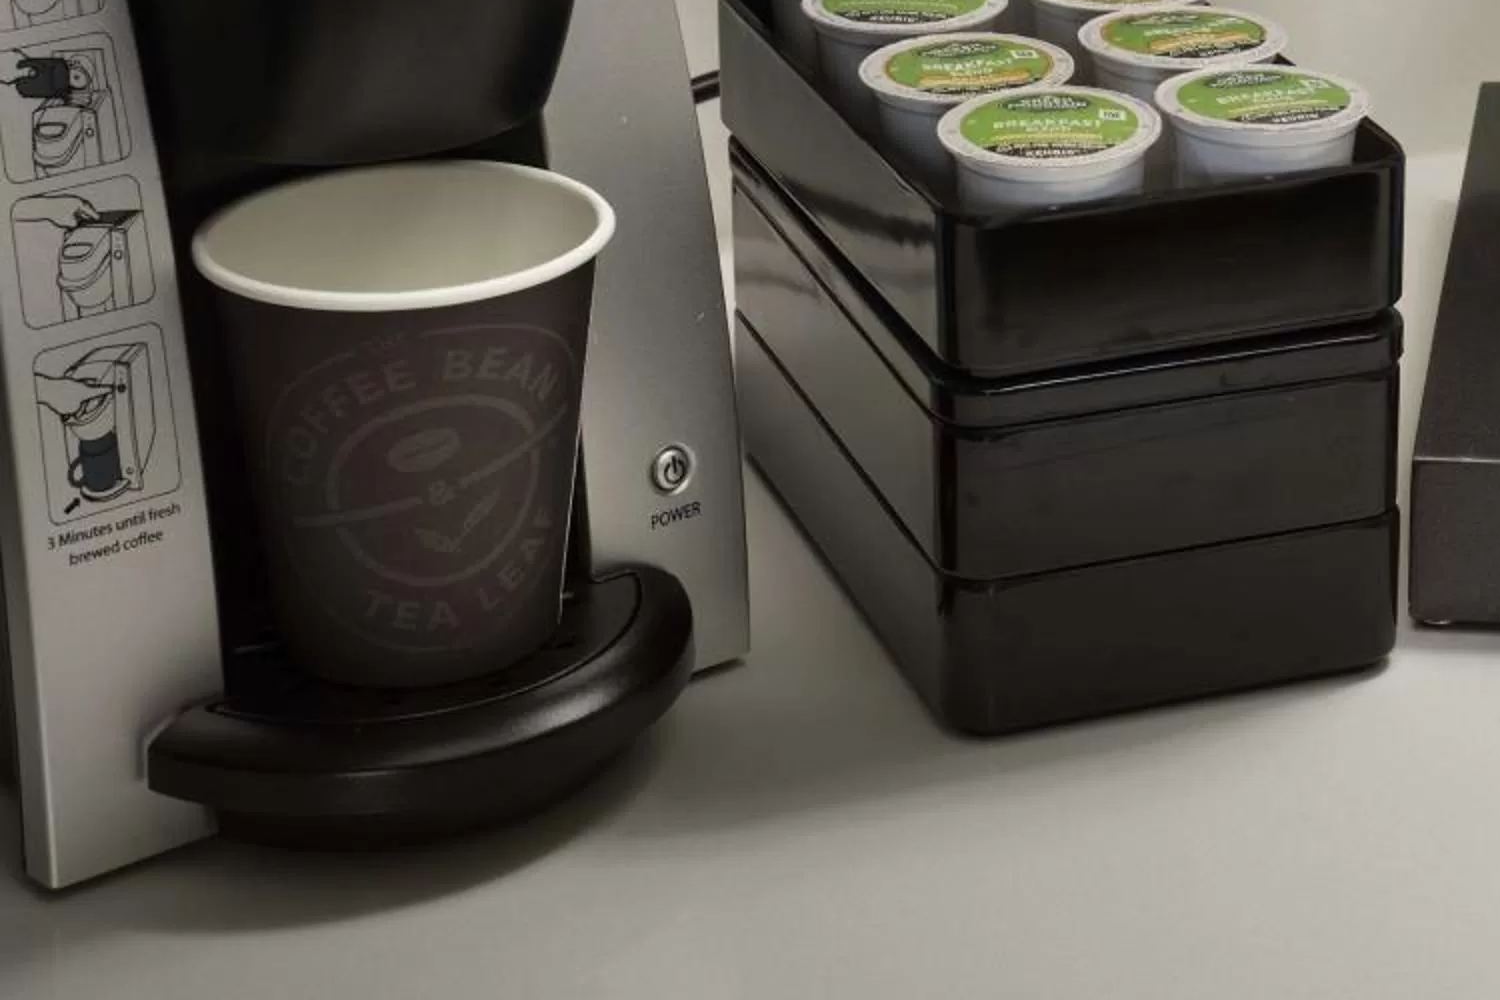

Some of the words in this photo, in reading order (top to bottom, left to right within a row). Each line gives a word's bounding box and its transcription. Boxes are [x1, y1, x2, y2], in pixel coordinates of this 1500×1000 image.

[442, 346, 558, 402] BEAN
[48, 536, 56, 551] 3
[58, 521, 113, 548] Minutes
[115, 509, 146, 531] until
[148, 502, 182, 522] fresh
[650, 500, 702, 531] POWER
[68, 539, 122, 567] brewed
[122, 530, 164, 551] coffee
[363, 588, 461, 632] TEA
[478, 510, 554, 612] LEAF
